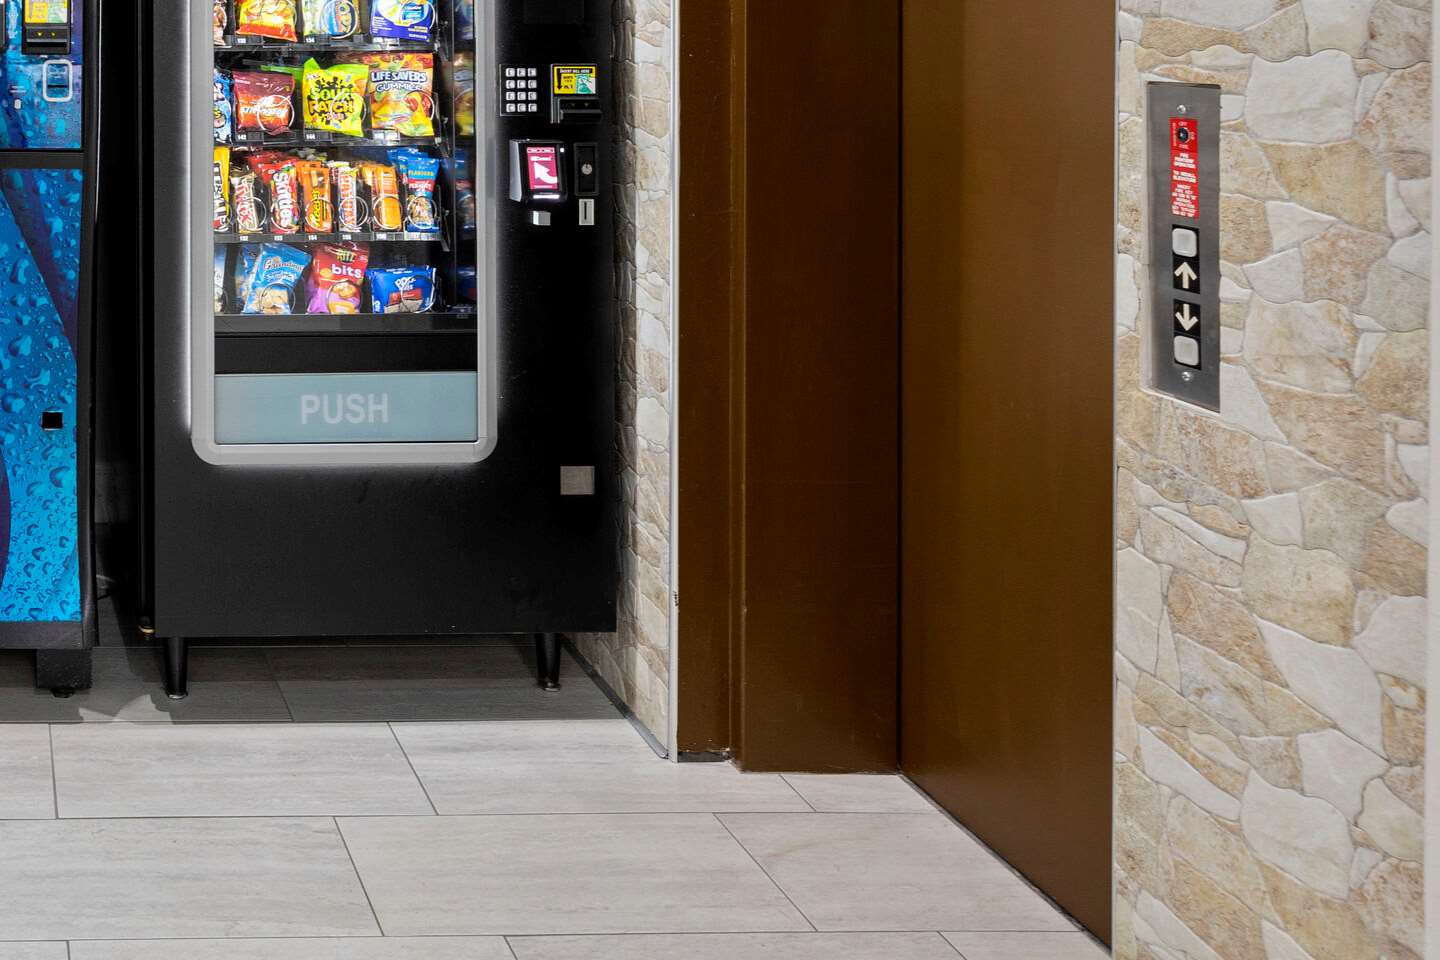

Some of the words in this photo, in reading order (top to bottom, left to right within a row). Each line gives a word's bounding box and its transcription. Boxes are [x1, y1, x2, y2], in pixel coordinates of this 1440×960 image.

[371, 72, 392, 81] LIFE
[392, 70, 427, 82] SAVERS
[310, 88, 354, 101] SOUR
[272, 172, 292, 228] Skittles
[331, 264, 362, 278] bits
[300, 393, 389, 424] PUSH
